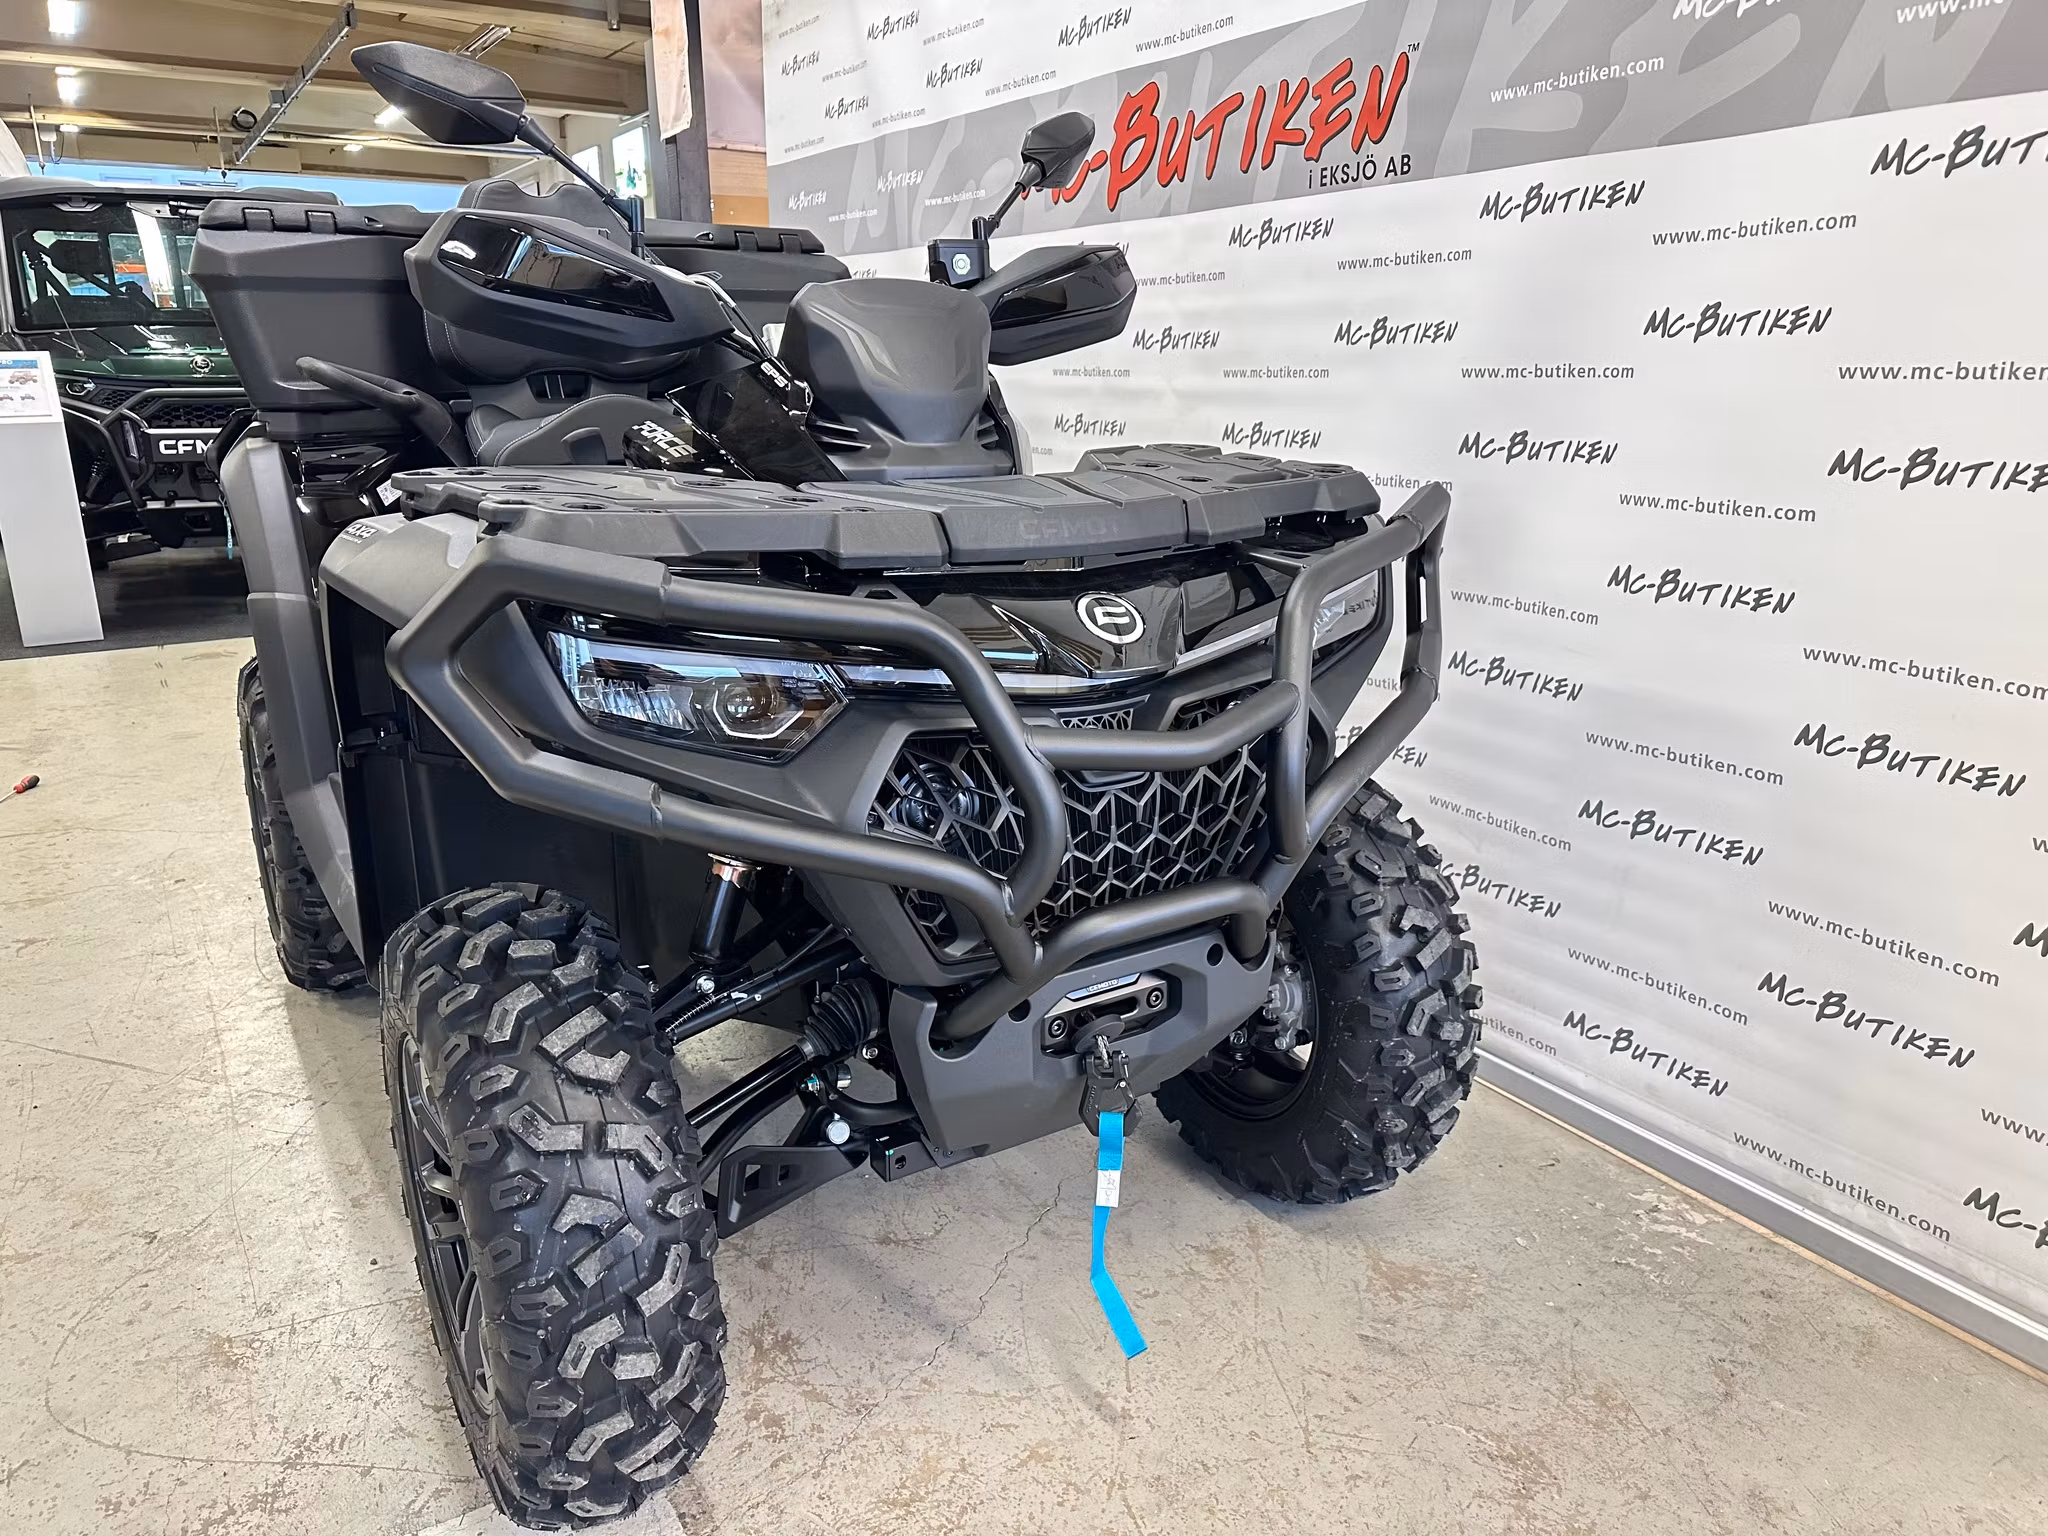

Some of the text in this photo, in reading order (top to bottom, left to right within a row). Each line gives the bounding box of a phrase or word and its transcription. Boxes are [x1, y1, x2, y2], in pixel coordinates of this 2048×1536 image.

[923, 18, 984, 46] www.mc-butiken.com
[1136, 16, 1234, 52] www.mc-butiken.com
[985, 69, 1056, 96] www.mc-butiken.com
[1491, 57, 1664, 102] www.mc-butiken.com
[872, 108, 926, 128] www.mc-butiken.com
[1870, 125, 2048, 178] MC-BUT
[1309, 154, 1411, 189] i EKSJÖ AB
[925, 190, 985, 206] www.mc-butiken.com
[1653, 215, 1856, 245] www.mc-butiken.com
[1338, 250, 1471, 270] www.mc-butiken.com
[760, 361, 789, 388] EPS
[1053, 366, 1130, 377] www.mc-butiken.com
[1223, 366, 1329, 378] www.mc-butiken.com
[1462, 363, 1634, 378] www.mc-butiken.com
[159, 439, 213, 454] CFM
[632, 421, 698, 458] FORCE
[1620, 494, 1815, 522] www.mc-butiken.com
[1451, 591, 1598, 625] www.mc-butiken.com
[1586, 732, 1783, 785] www.mc-butiken.com
[1429, 795, 1572, 852] www.mc-butiken.com
[1439, 862, 1561, 918] C-BUTIKEN
[1768, 901, 2000, 987] www.mc-butiken.com
[1568, 948, 1748, 1026] www.mc-butiken.com
[1733, 1132, 1950, 1242] www.mc-butiken.com
